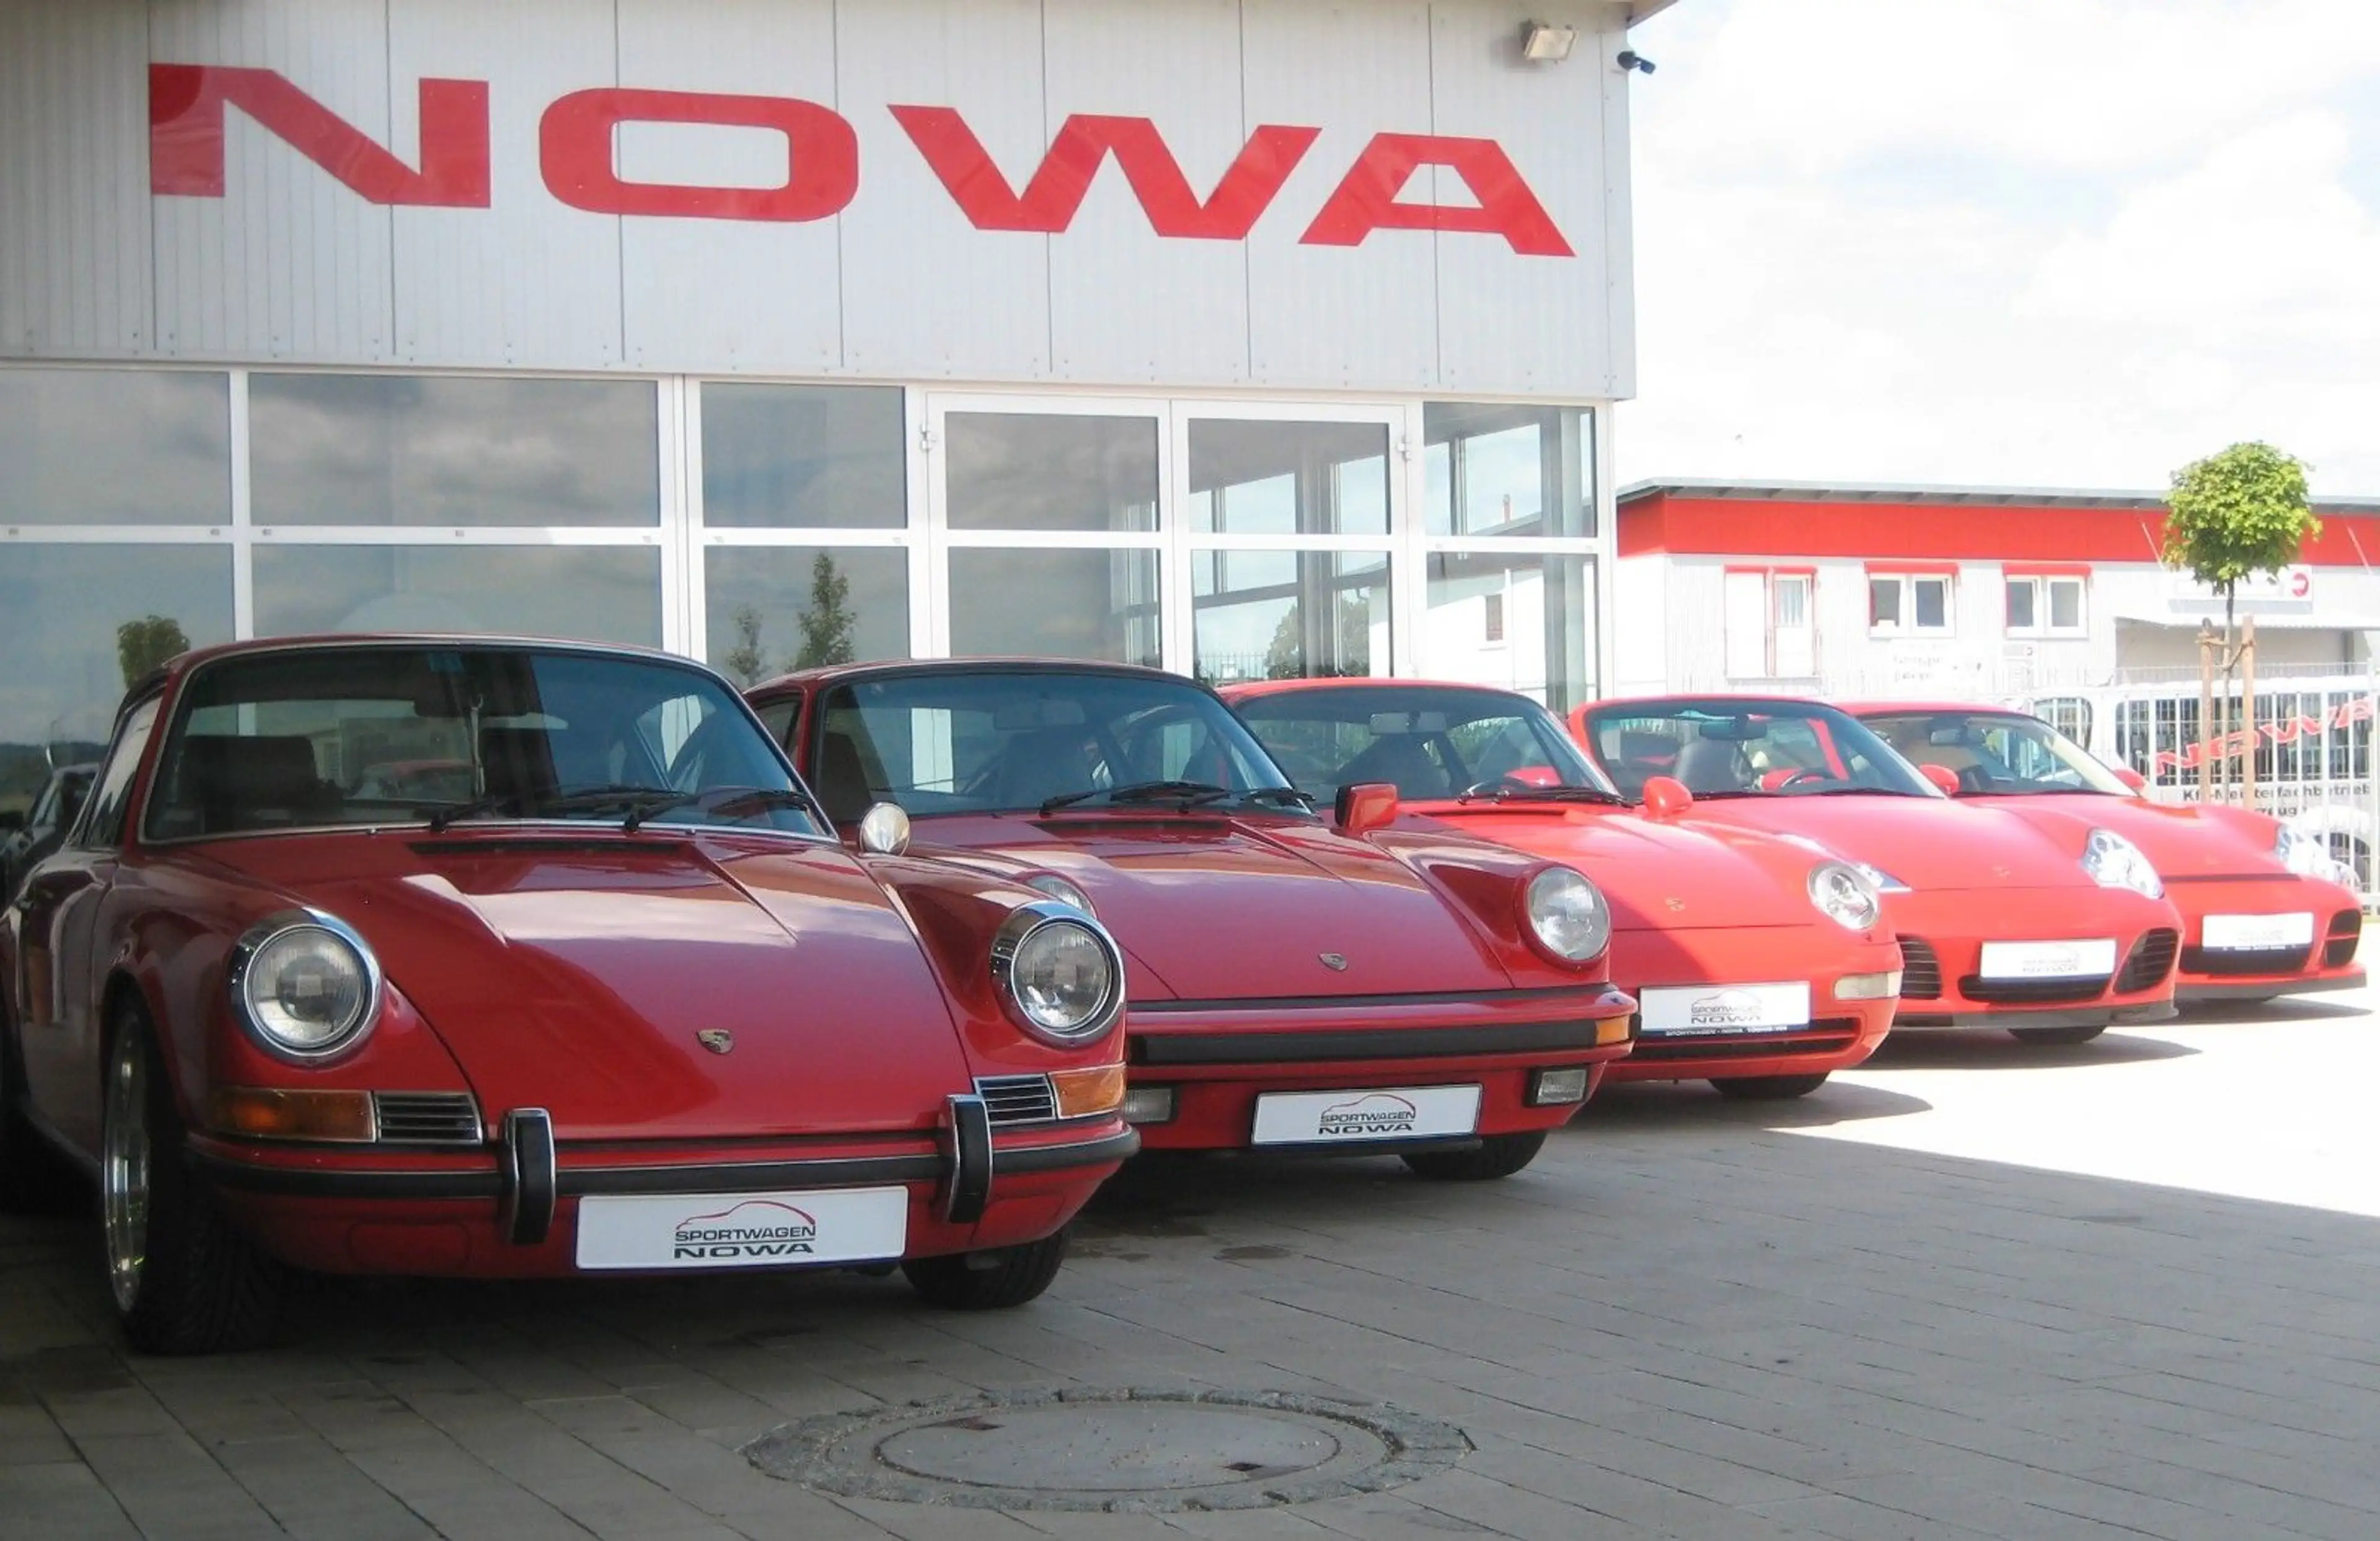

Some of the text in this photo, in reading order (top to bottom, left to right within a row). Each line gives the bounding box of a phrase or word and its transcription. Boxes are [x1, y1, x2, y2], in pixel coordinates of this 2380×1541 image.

[149, 63, 1576, 257] NOWA
[1321, 1111, 1416, 1123] SPORTWAGEN
[1318, 1123, 1413, 1135] NOWA
[675, 1225, 816, 1242] SPORTWAGEN
[674, 1243, 814, 1259] NOWA
